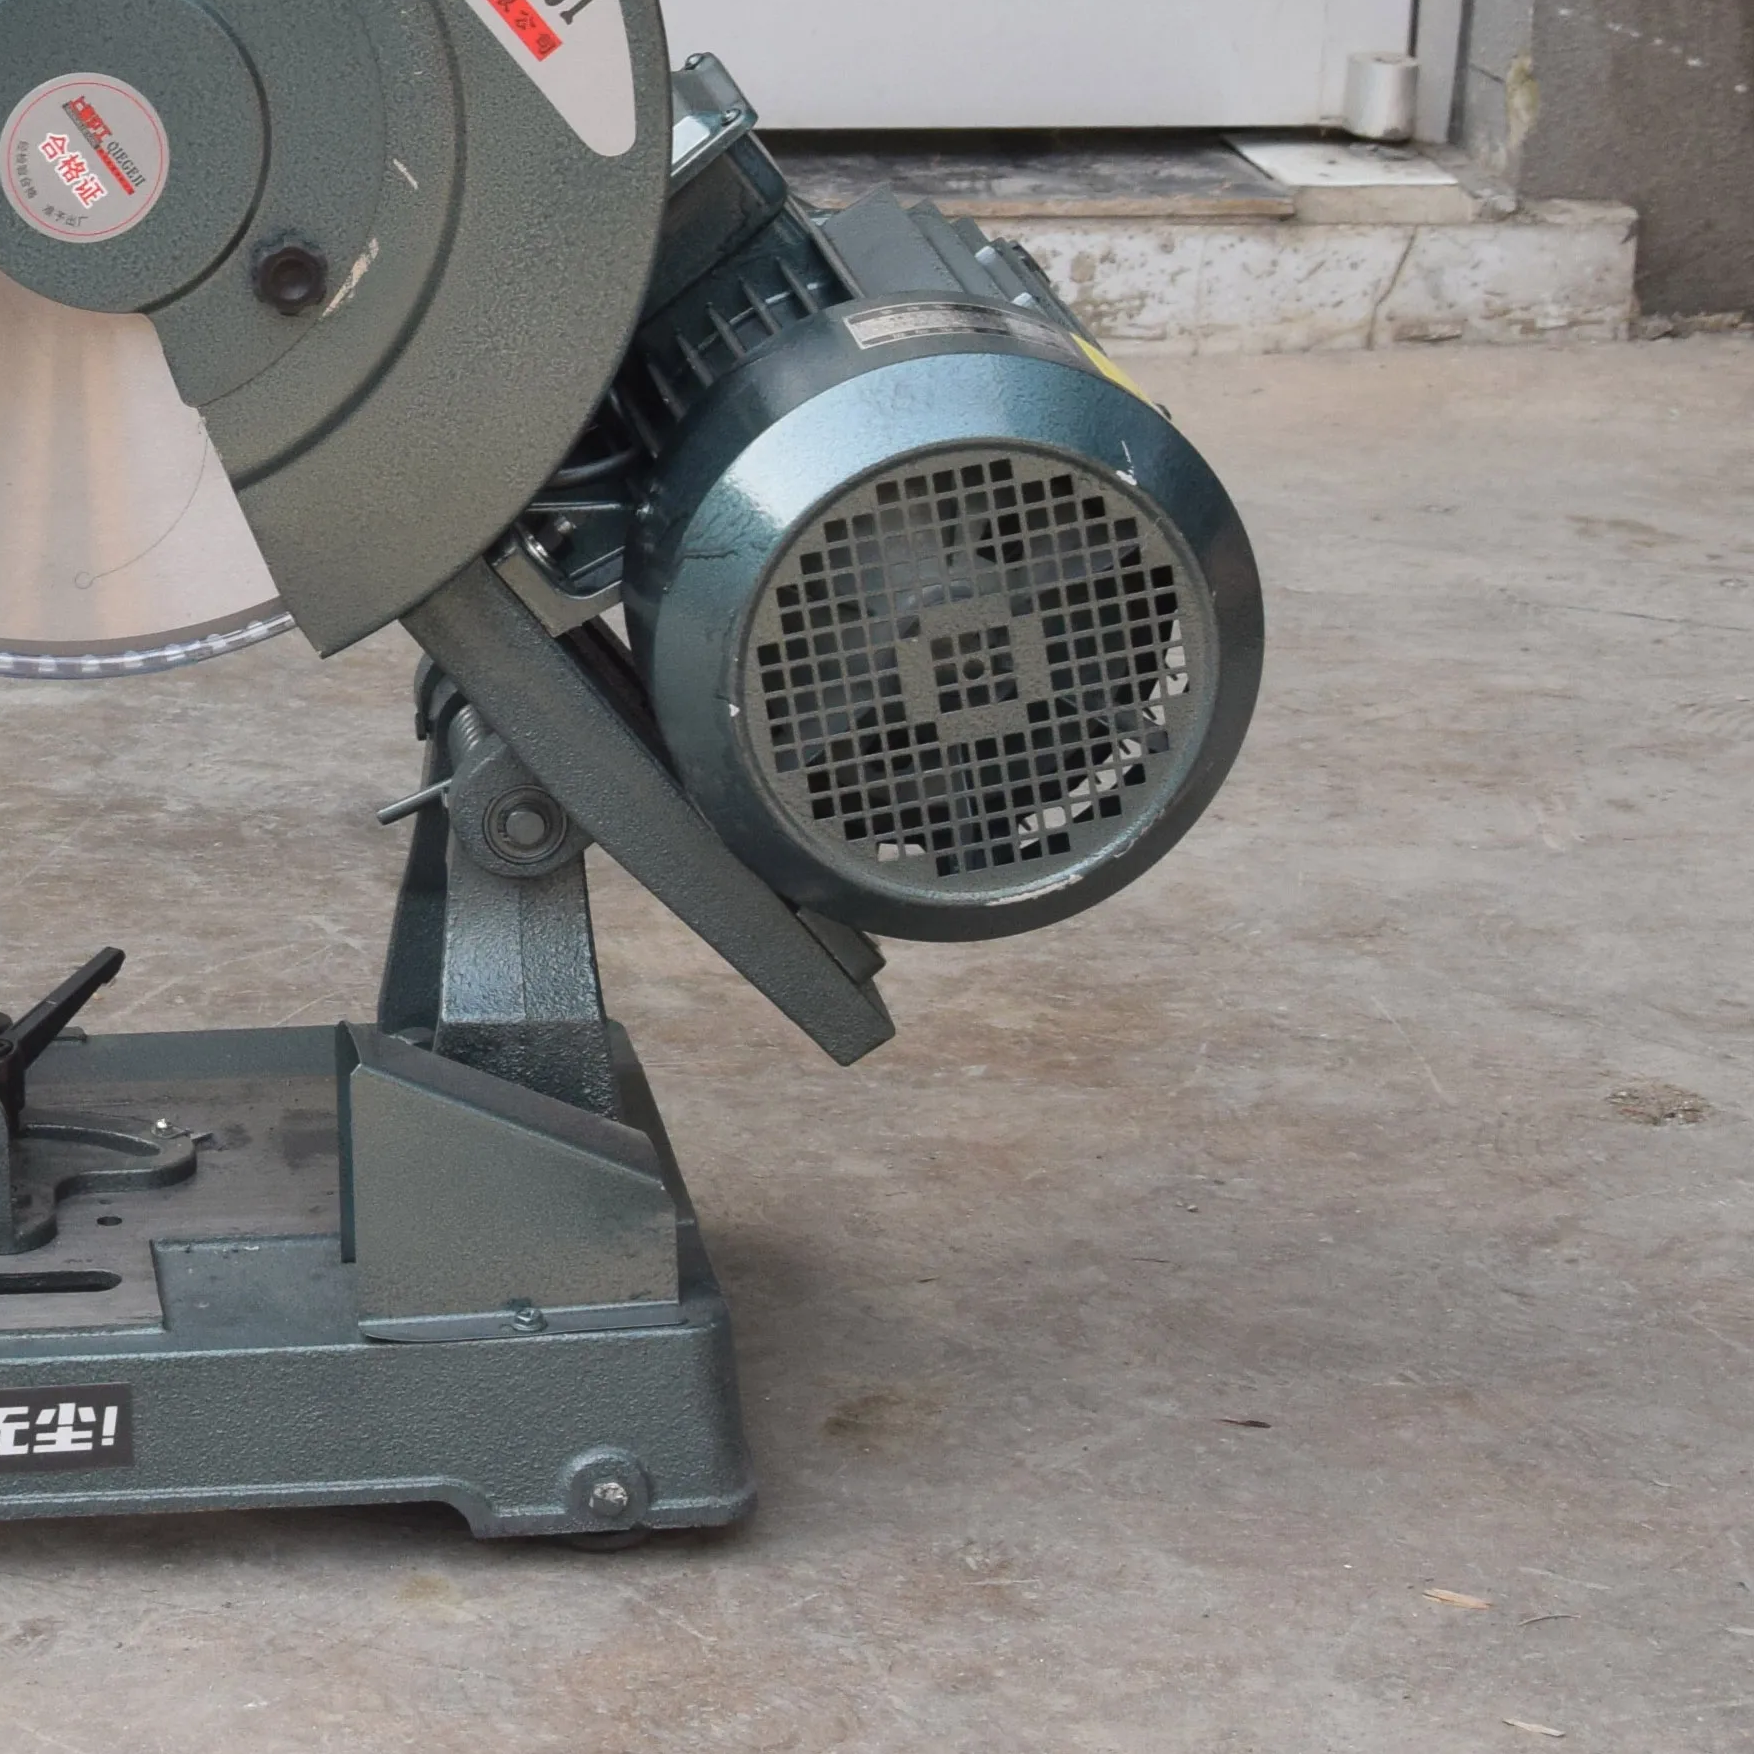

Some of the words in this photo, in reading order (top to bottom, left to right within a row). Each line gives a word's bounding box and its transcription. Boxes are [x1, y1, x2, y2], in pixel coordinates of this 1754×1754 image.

[40, 134, 106, 207] 合格证
[107, 141, 146, 187] QIEGEJI
